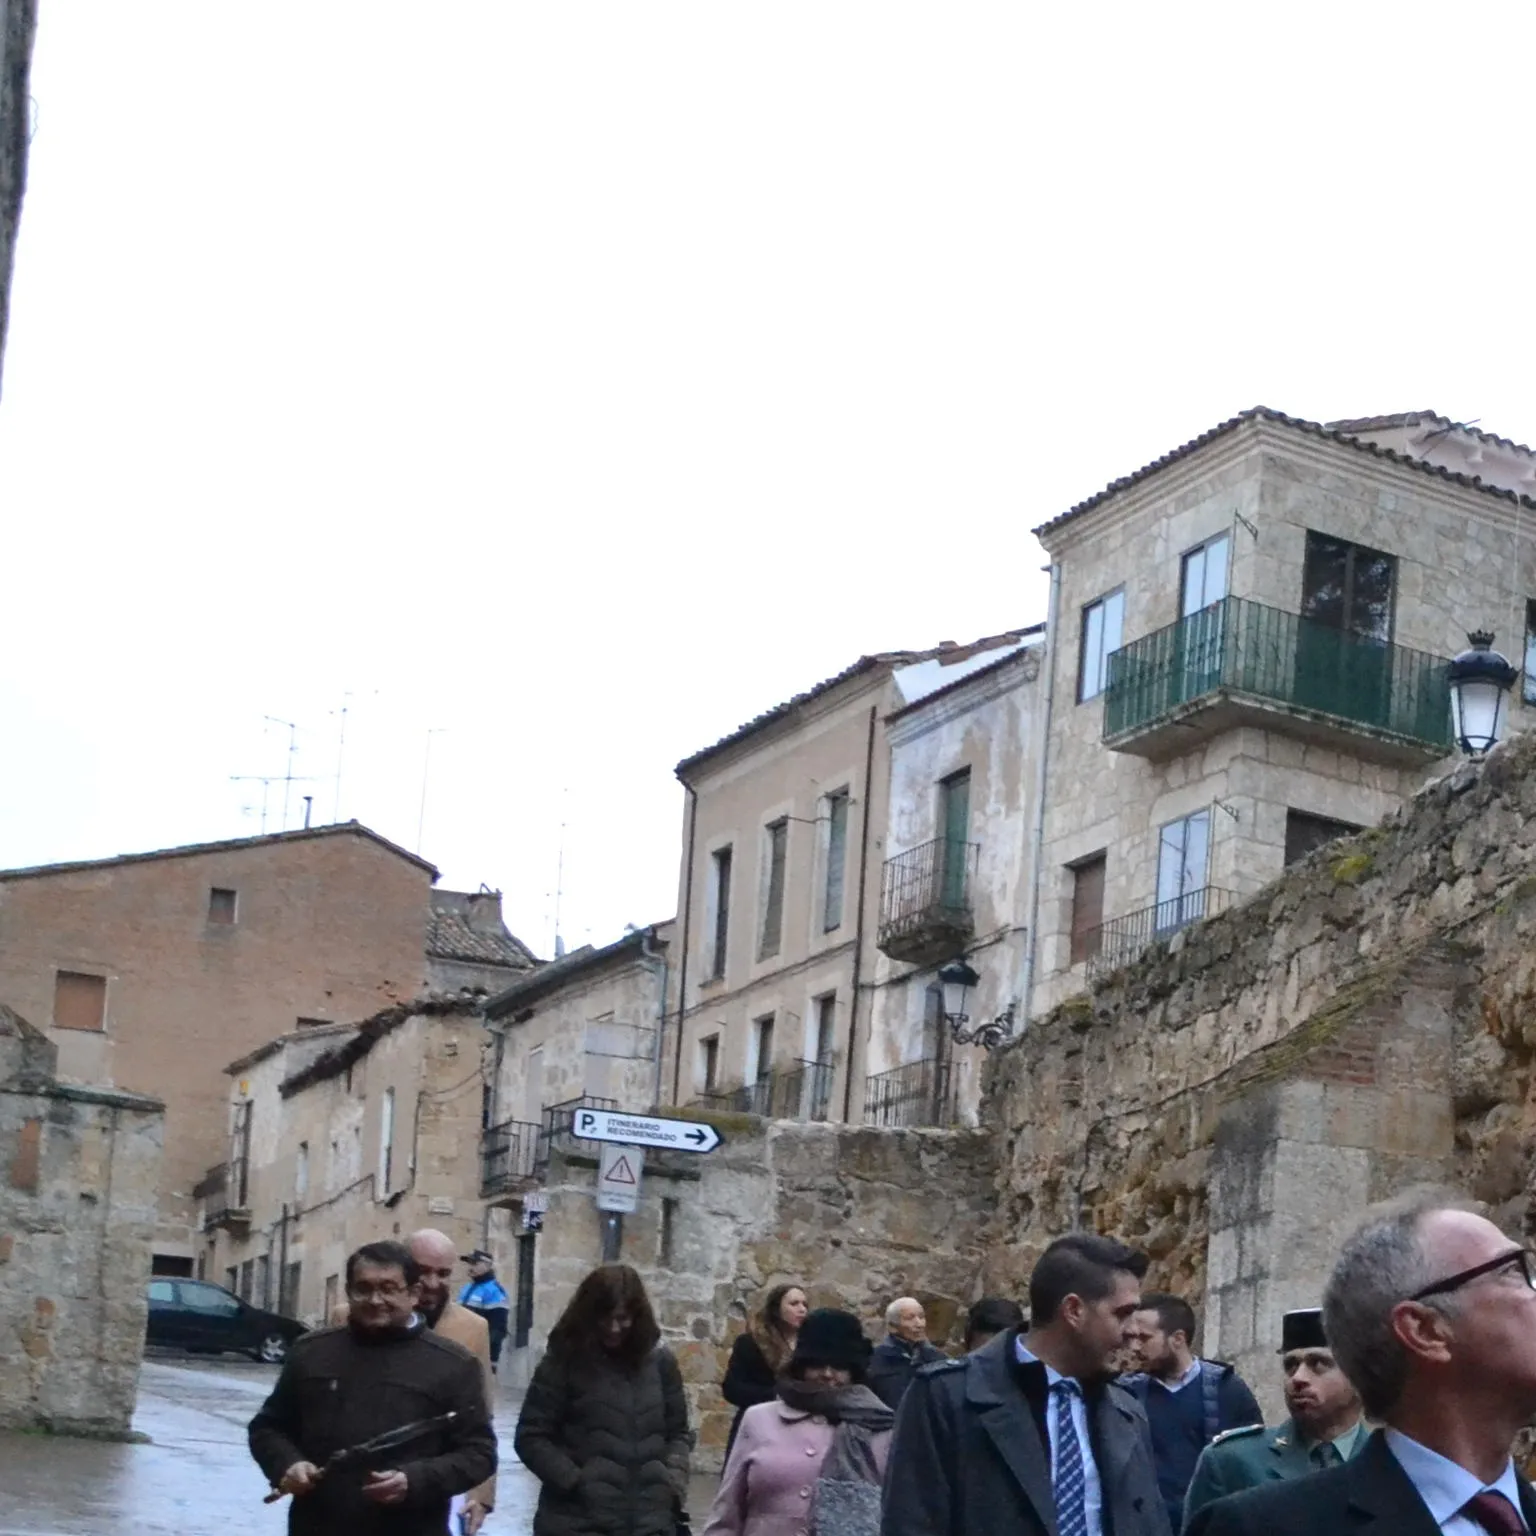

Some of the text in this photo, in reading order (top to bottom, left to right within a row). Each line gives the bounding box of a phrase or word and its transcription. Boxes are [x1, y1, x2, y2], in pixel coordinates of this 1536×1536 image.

[581, 1114, 595, 1131] P
[607, 1118, 661, 1132] ITINERARIO
[607, 1127, 678, 1142] RECOMENDADO
